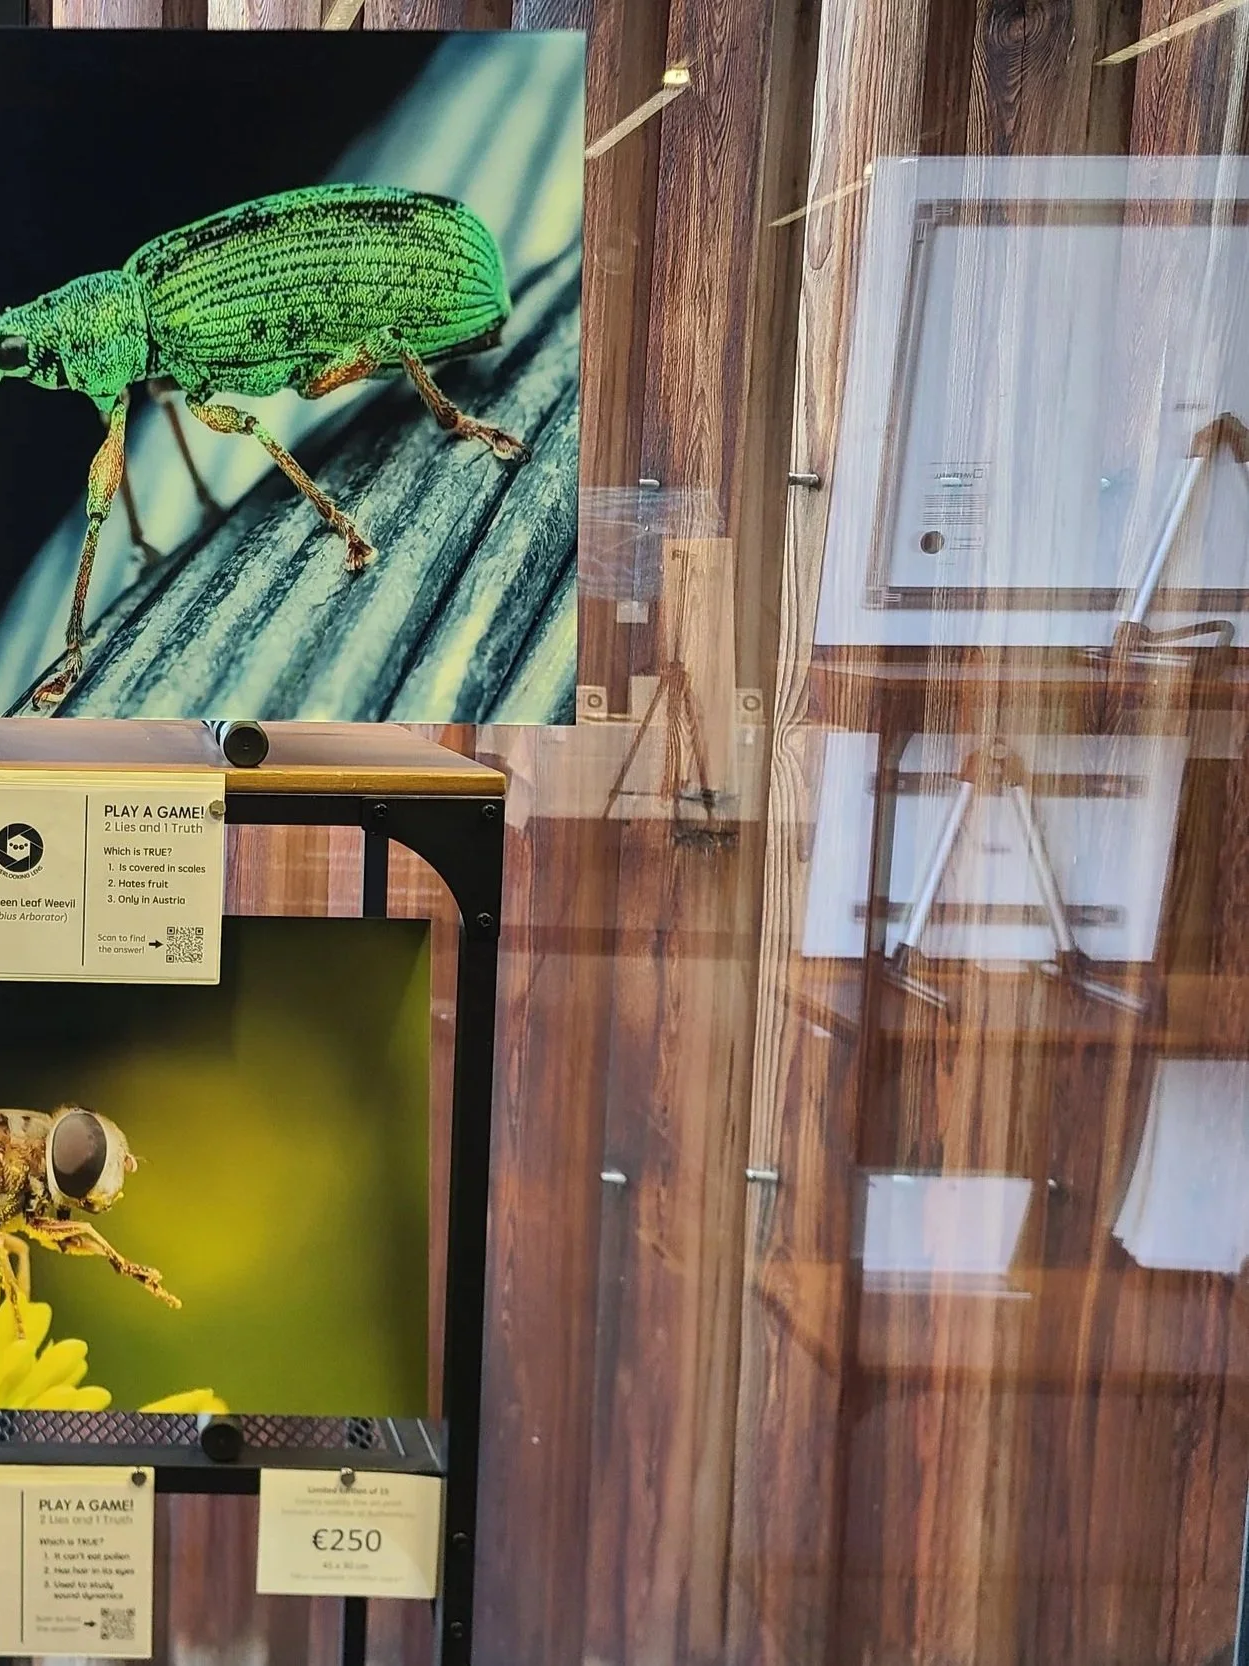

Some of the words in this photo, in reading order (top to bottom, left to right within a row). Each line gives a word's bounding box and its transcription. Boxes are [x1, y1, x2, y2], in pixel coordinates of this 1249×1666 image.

[104, 805, 139, 818] PLAY
[143, 805, 153, 818] A
[157, 806, 205, 819] GAME!
[105, 822, 111, 831] 2
[115, 822, 136, 832] Lies
[139, 822, 160, 833] and
[164, 823, 168, 832] 1
[172, 823, 203, 834] Truth
[104, 847, 131, 856] Which
[133, 847, 141, 856] is
[143, 848, 172, 857] TRUE?
[30, 865, 43, 877] LENS
[108, 863, 114, 871] 1.
[119, 864, 127, 872] Is
[129, 864, 165, 872] covered
[167, 864, 176, 872] in
[178, 864, 206, 873] scales
[108, 879, 116, 888] 2.
[119, 880, 145, 888] Hates
[148, 880, 168, 888] fruit
[20, 898, 42, 907] Leaf
[45, 899, 76, 908] Weevil
[107, 895, 115, 903] 3.
[118, 895, 139, 905] Only
[141, 896, 150, 904] in
[152, 896, 186, 905] Austria
[19, 912, 68, 922] Arborator)
[98, 934, 117, 942] Scan
[129, 934, 146, 942] find
[113, 946, 145, 954] answer!
[39, 1499, 71, 1511] PLAY
[76, 1499, 85, 1511] A
[89, 1499, 134, 1512] GAME!
[312, 1528, 382, 1552] €250
